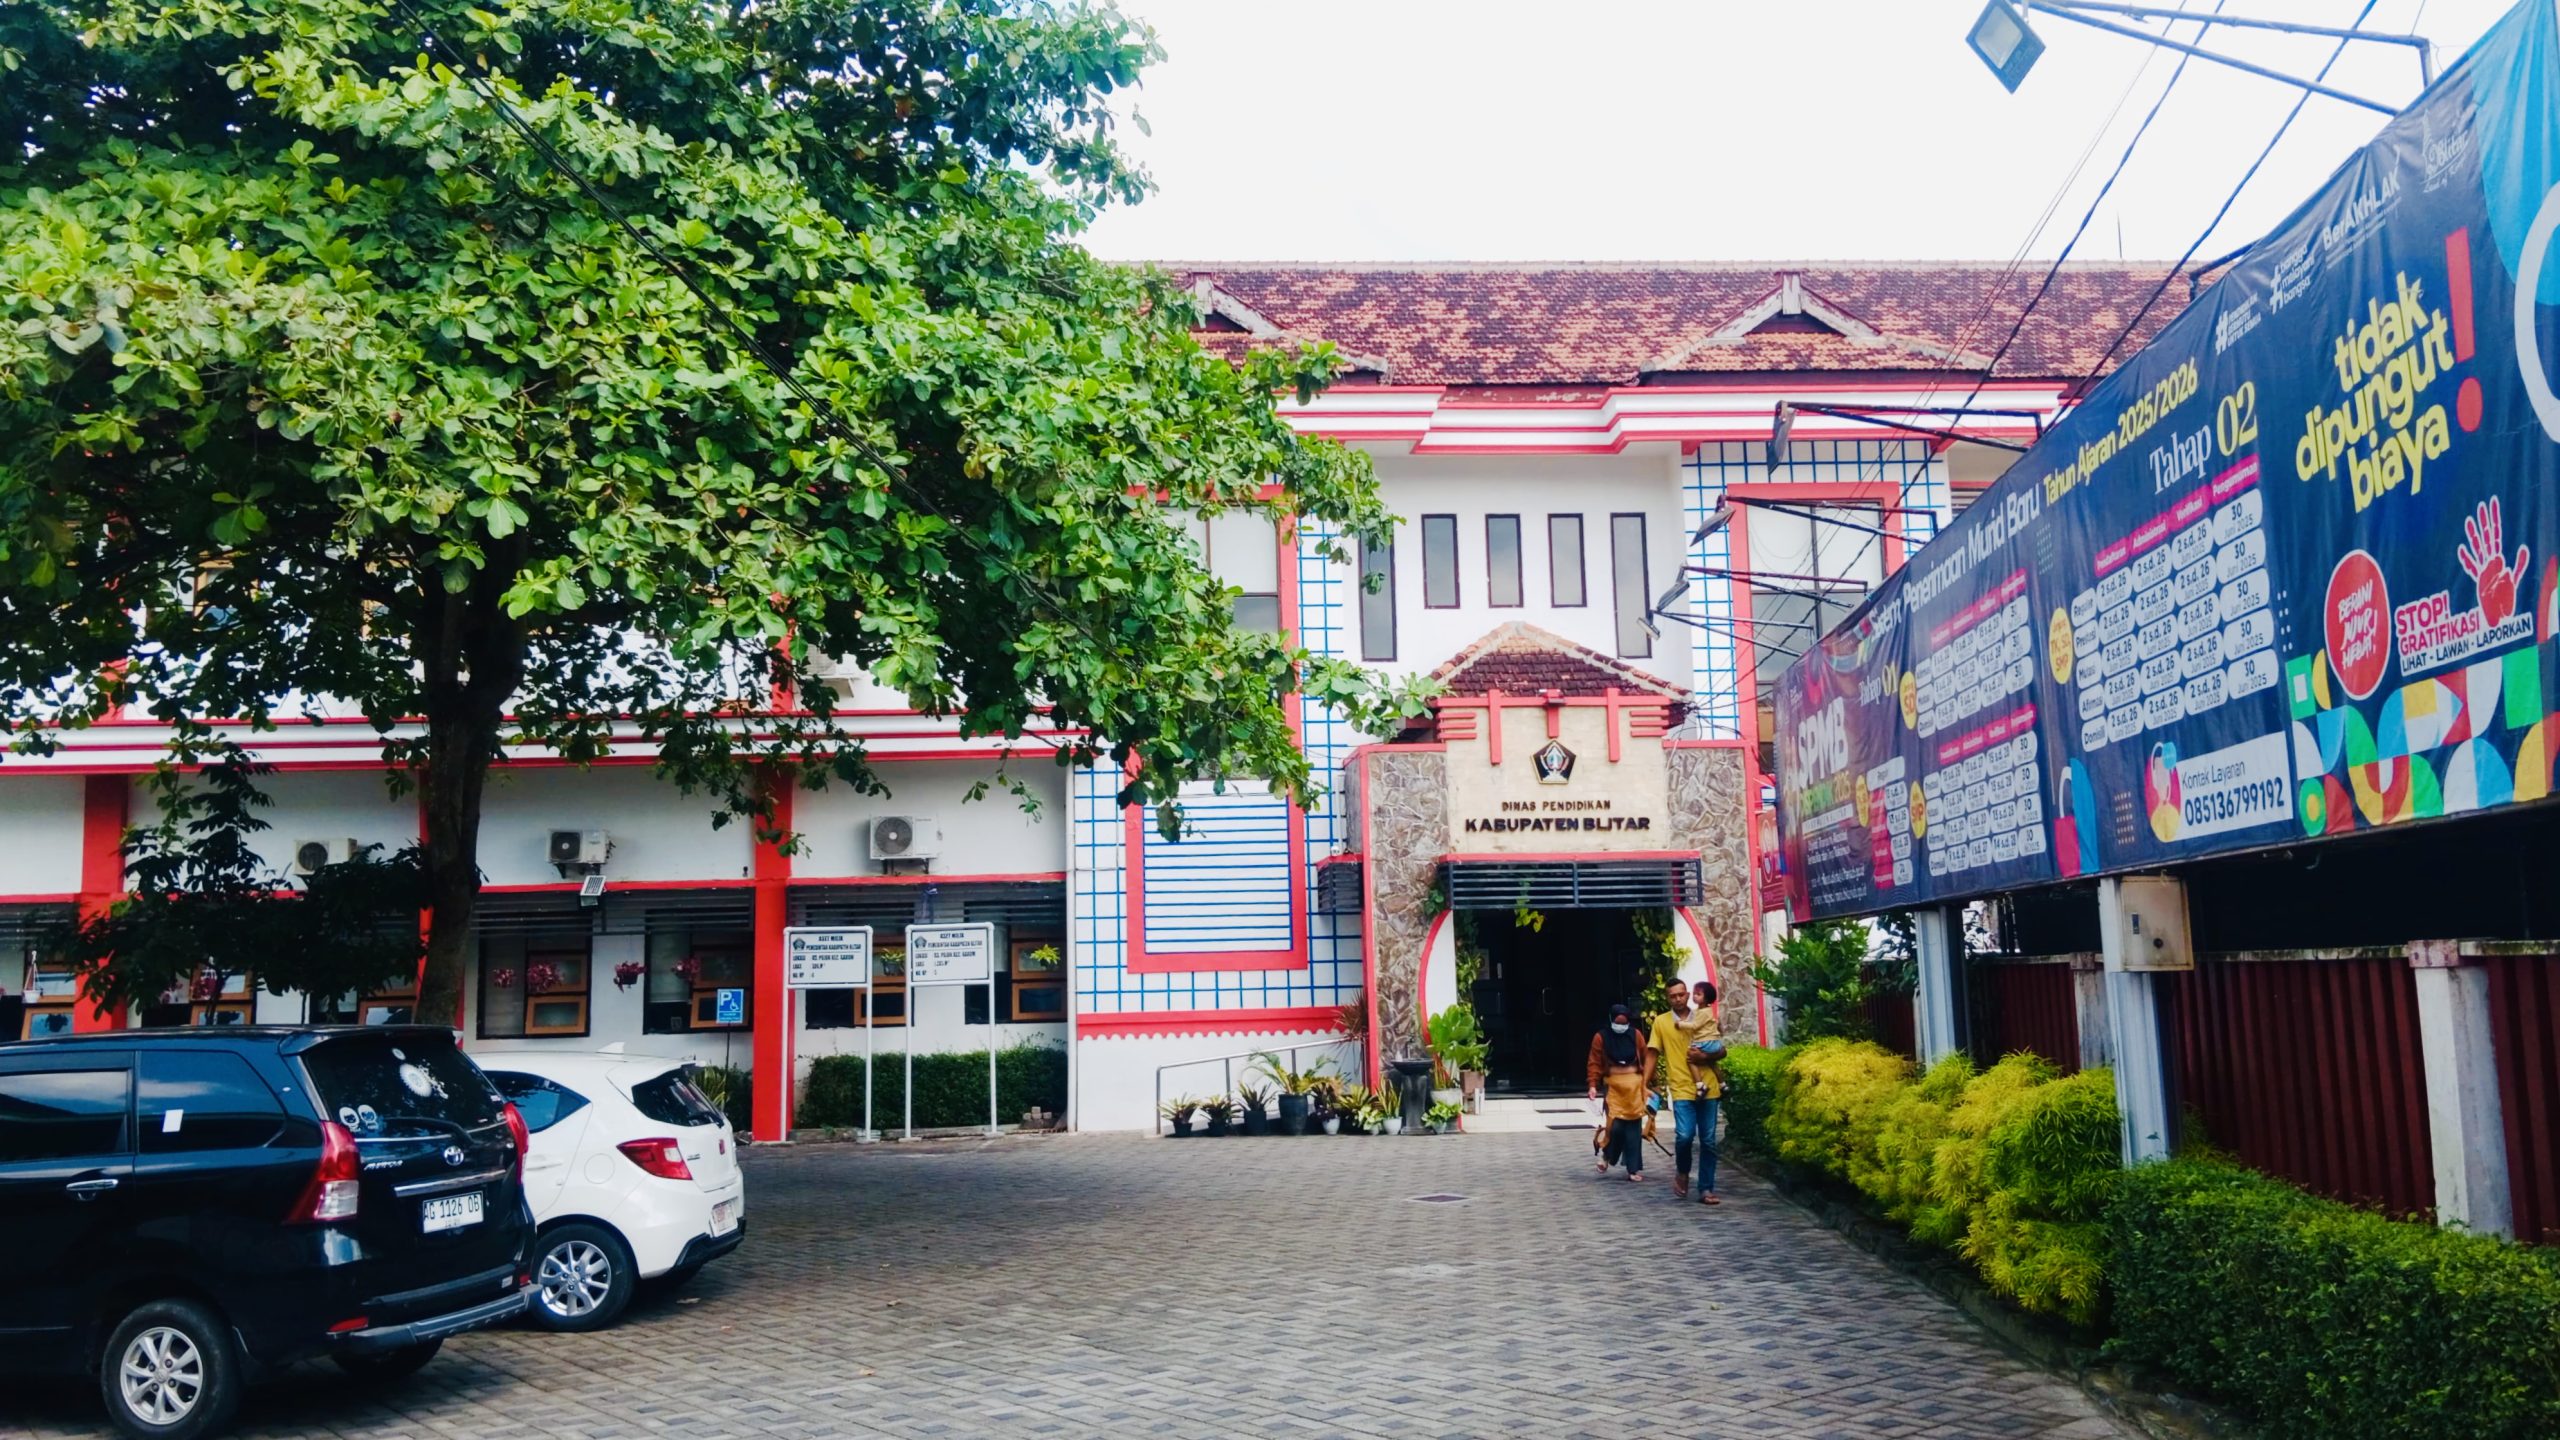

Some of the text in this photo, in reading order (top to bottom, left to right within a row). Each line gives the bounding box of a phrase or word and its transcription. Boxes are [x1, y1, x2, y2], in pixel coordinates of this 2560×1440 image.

[2284, 276, 2311, 304] bangsa
[2334, 271, 2428, 392] tidak
[2296, 308, 2454, 481] dipungut
[2149, 381, 2258, 495] Tahap 02
[2347, 404, 2450, 514] biaya
[1903, 543, 1966, 612] Penerimaan
[1968, 517, 2005, 566] Murid
[2007, 484, 2041, 538] Baru
[2043, 467, 2076, 507] Tahun
[2076, 429, 2117, 486] Ajaran
[2118, 357, 2198, 450] 2025/2026
[2231, 502, 2242, 520] 30
[2237, 513, 2253, 532] 2025
[2177, 539, 2182, 553] 2
[2197, 523, 2206, 541] 26
[2234, 541, 2245, 559] 30
[2137, 563, 2142, 576] 2
[2157, 549, 2165, 565] 26
[2180, 575, 2185, 589] 2
[2200, 560, 2209, 578] 26
[2240, 553, 2256, 571] 2025
[2101, 584, 2105, 597] 2
[2118, 572, 2126, 587] 26
[2140, 597, 2144, 610] 2
[2159, 584, 2168, 600] 26
[2237, 580, 2248, 598] 30
[2183, 611, 2188, 625] 2
[2203, 598, 2213, 615] 26
[2243, 592, 2260, 610] 2025
[2337, 578, 2373, 624] BERANI
[2103, 616, 2108, 629] 2
[2121, 605, 2129, 620] 26
[2397, 593, 2449, 635] STOP!
[2143, 631, 2147, 645] 2
[2162, 619, 2171, 635] 26
[2240, 619, 2251, 637] 30
[2246, 632, 2263, 649] 2025
[2340, 608, 2373, 651] JUJUR
[2400, 610, 2481, 657] GRATIFIKASI
[2106, 649, 2110, 662] 2
[2123, 638, 2132, 653] 26
[2187, 648, 2192, 662] 2
[2207, 635, 2217, 653] 26
[2402, 617, 2532, 672] LIHAT LAWAN LAPORKAN
[1882, 662, 1898, 697] 01
[2146, 665, 2150, 679] 2
[2166, 655, 2174, 671] 26
[2244, 659, 2255, 676] 30
[2108, 682, 2113, 694] 2
[2126, 672, 2134, 687] 26
[2190, 684, 2195, 698] 2
[2212, 673, 2221, 690] 26
[2250, 673, 2267, 689] 2025
[2149, 700, 2154, 714] 2
[2169, 690, 2178, 706] 26
[2111, 714, 2115, 727] 2
[2129, 706, 2137, 721] 26
[1798, 696, 1849, 790] SPMB
[2182, 760, 2246, 791] Kontak Layanan
[1502, 799, 1611, 812] DINAS PENDIDIKAN
[2185, 776, 2285, 827] 085136799192
[1465, 816, 1650, 832] KABUPATEN BLITAR
[720, 991, 732, 1006] P
[423, 1204, 436, 1222] AG
[439, 1199, 463, 1219] 1126
